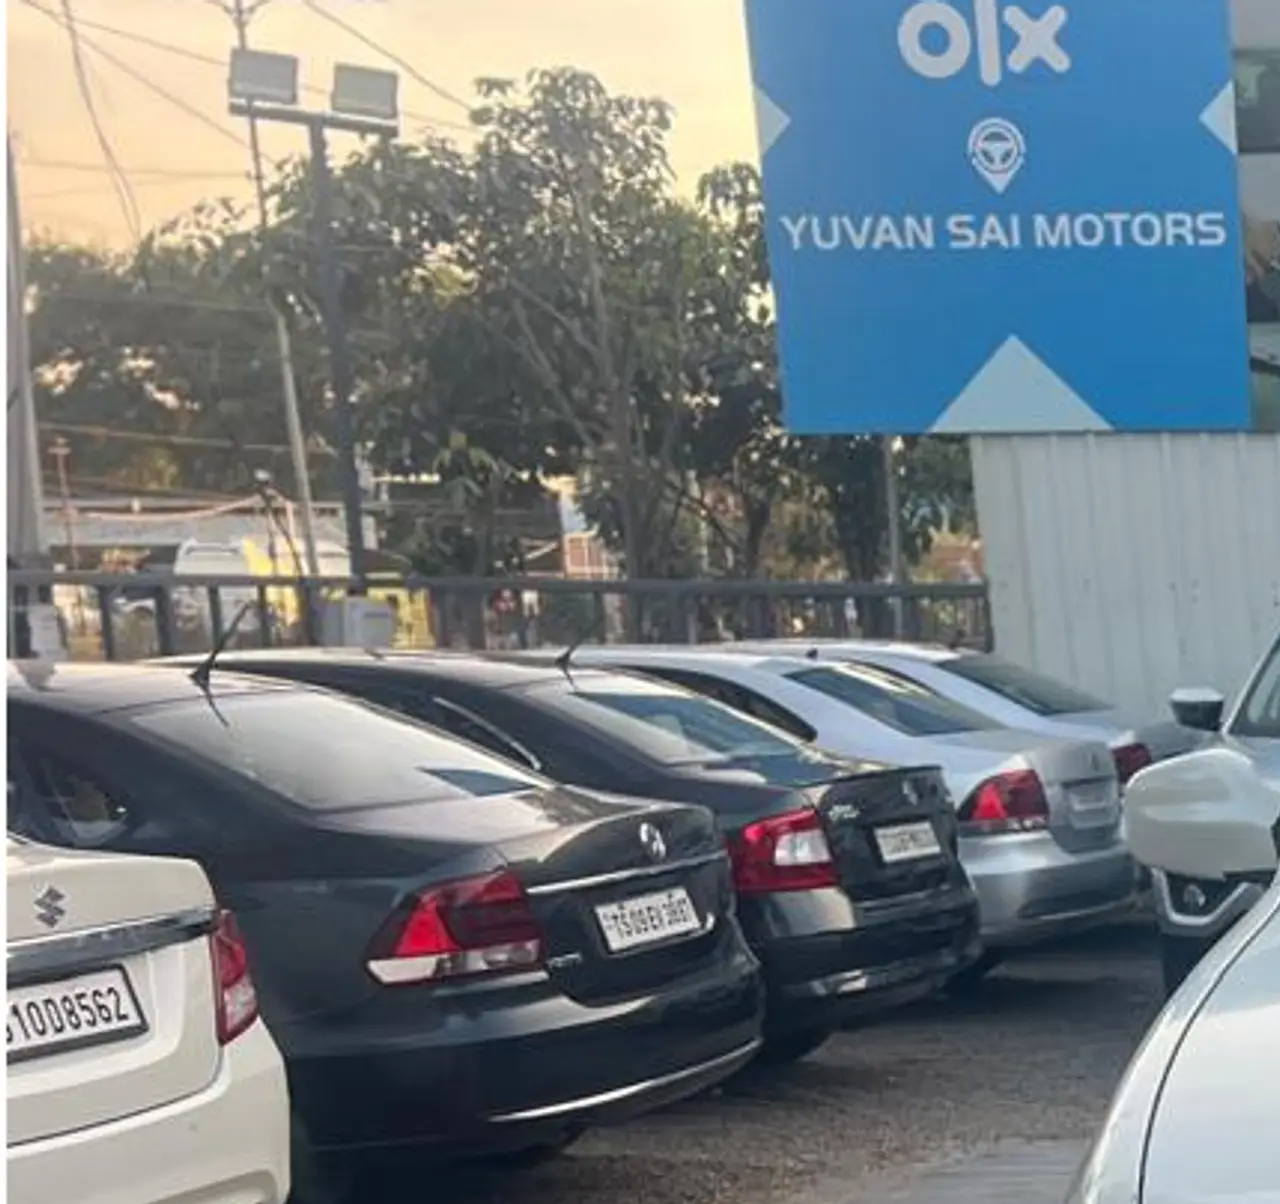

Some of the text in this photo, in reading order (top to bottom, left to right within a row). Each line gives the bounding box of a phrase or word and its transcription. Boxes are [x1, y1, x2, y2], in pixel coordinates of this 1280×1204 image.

[898, 0, 1072, 87] olx
[780, 211, 1228, 251] YUVAN SAI MOTORS
